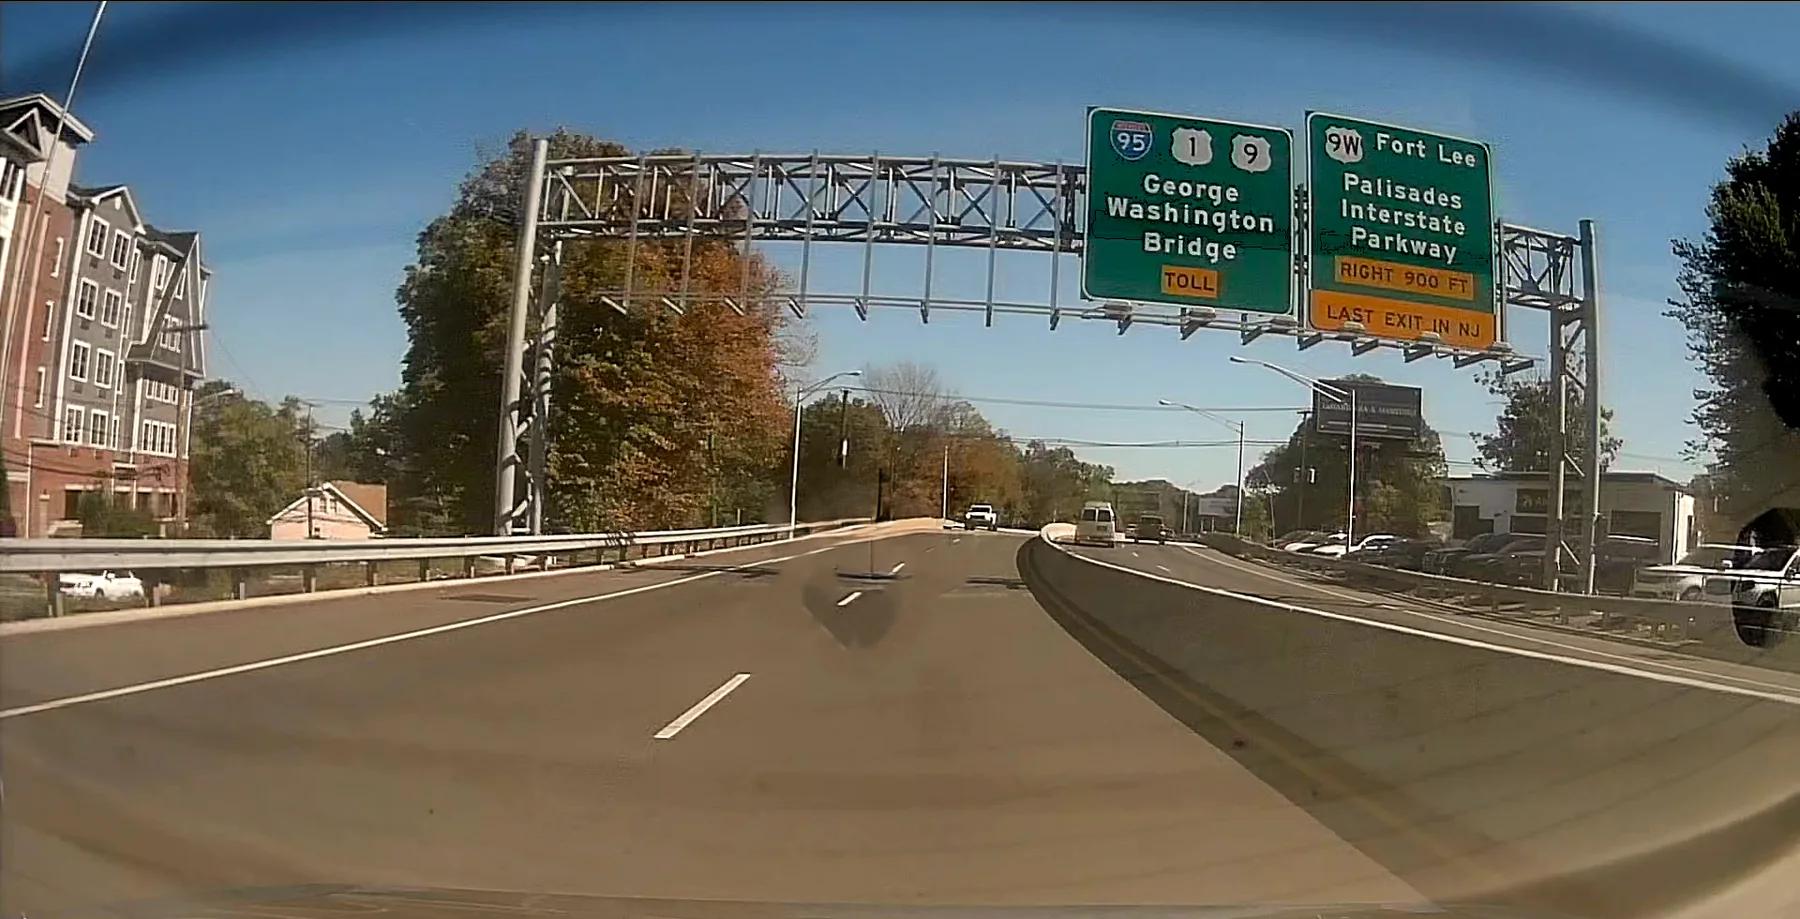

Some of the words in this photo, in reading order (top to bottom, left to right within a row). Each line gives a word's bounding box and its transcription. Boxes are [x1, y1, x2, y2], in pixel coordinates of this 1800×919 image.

[1116, 132, 1146, 151] 95
[1189, 137, 1196, 156] 1
[1243, 143, 1258, 164] 9
[1327, 133, 1361, 156] 9W
[1376, 133, 1426, 158] Fort
[1438, 144, 1477, 167] Lee
[1144, 174, 1239, 206] George
[1344, 172, 1463, 210] Palisades
[1107, 197, 1274, 233] Washington
[1341, 198, 1467, 236] Interstate
[1144, 232, 1237, 263] Bridge
[1351, 226, 1458, 264] Parkway
[1164, 272, 1215, 291] TOLL
[1340, 262, 1395, 282] RIGHT
[1404, 271, 1439, 288] 900
[1448, 277, 1469, 294] FT
[1327, 304, 1374, 324] LAST
[1384, 312, 1424, 331] EXIT
[1432, 318, 1450, 335] IN
[1459, 321, 1481, 338] NJ
